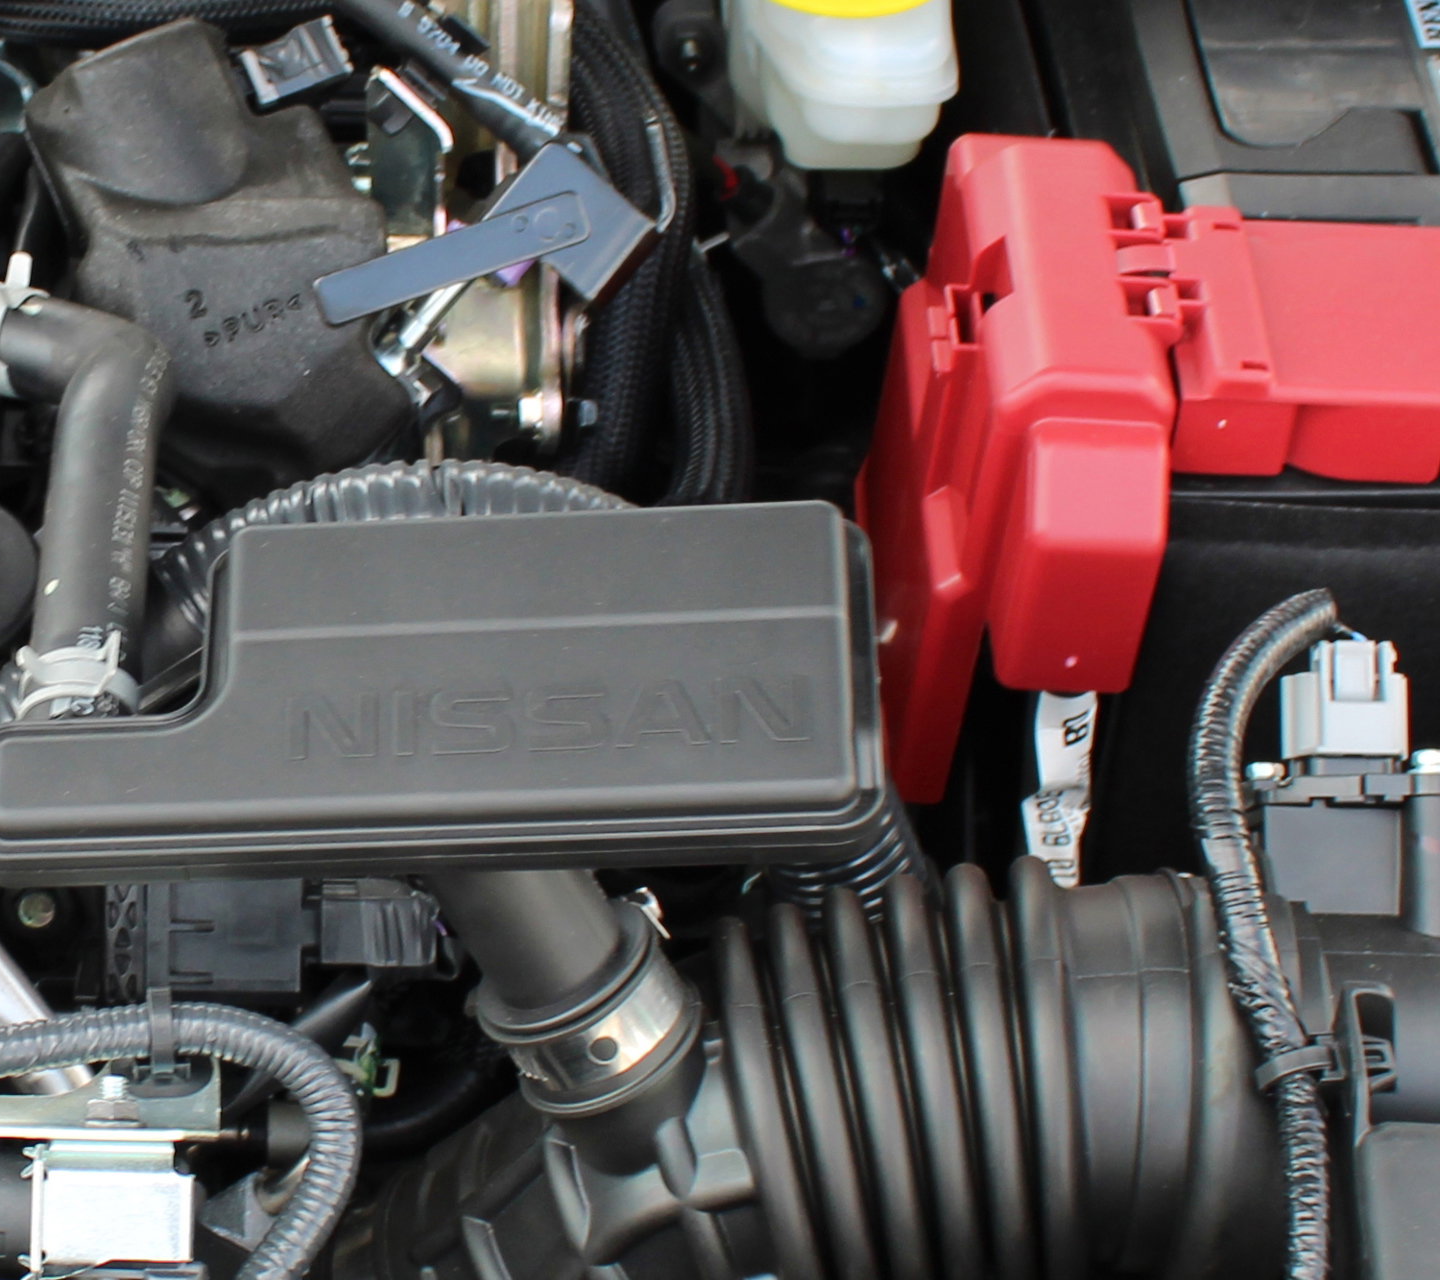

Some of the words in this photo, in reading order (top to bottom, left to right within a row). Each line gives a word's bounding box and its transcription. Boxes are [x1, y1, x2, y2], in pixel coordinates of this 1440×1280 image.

[491, 72, 526, 101] NOT
[184, 288, 208, 319] 2
[286, 676, 811, 761] NISSAN
